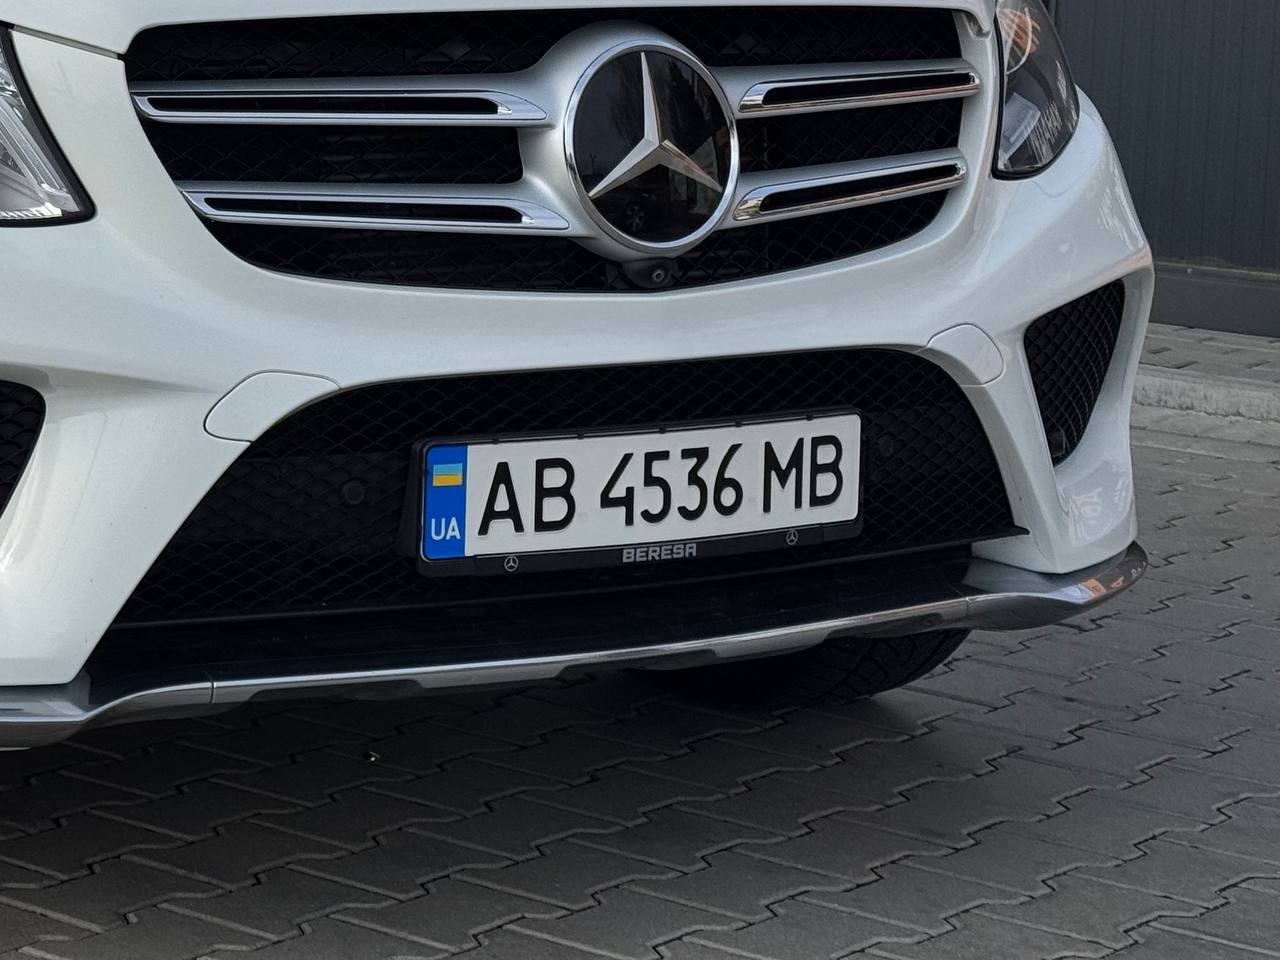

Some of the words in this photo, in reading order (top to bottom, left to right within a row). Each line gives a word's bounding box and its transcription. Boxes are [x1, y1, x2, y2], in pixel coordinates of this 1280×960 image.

[477, 457, 576, 536] AB
[600, 443, 744, 527] 4536
[762, 435, 844, 513] MB
[431, 516, 461, 541] UA
[622, 542, 697, 564] BERESA
